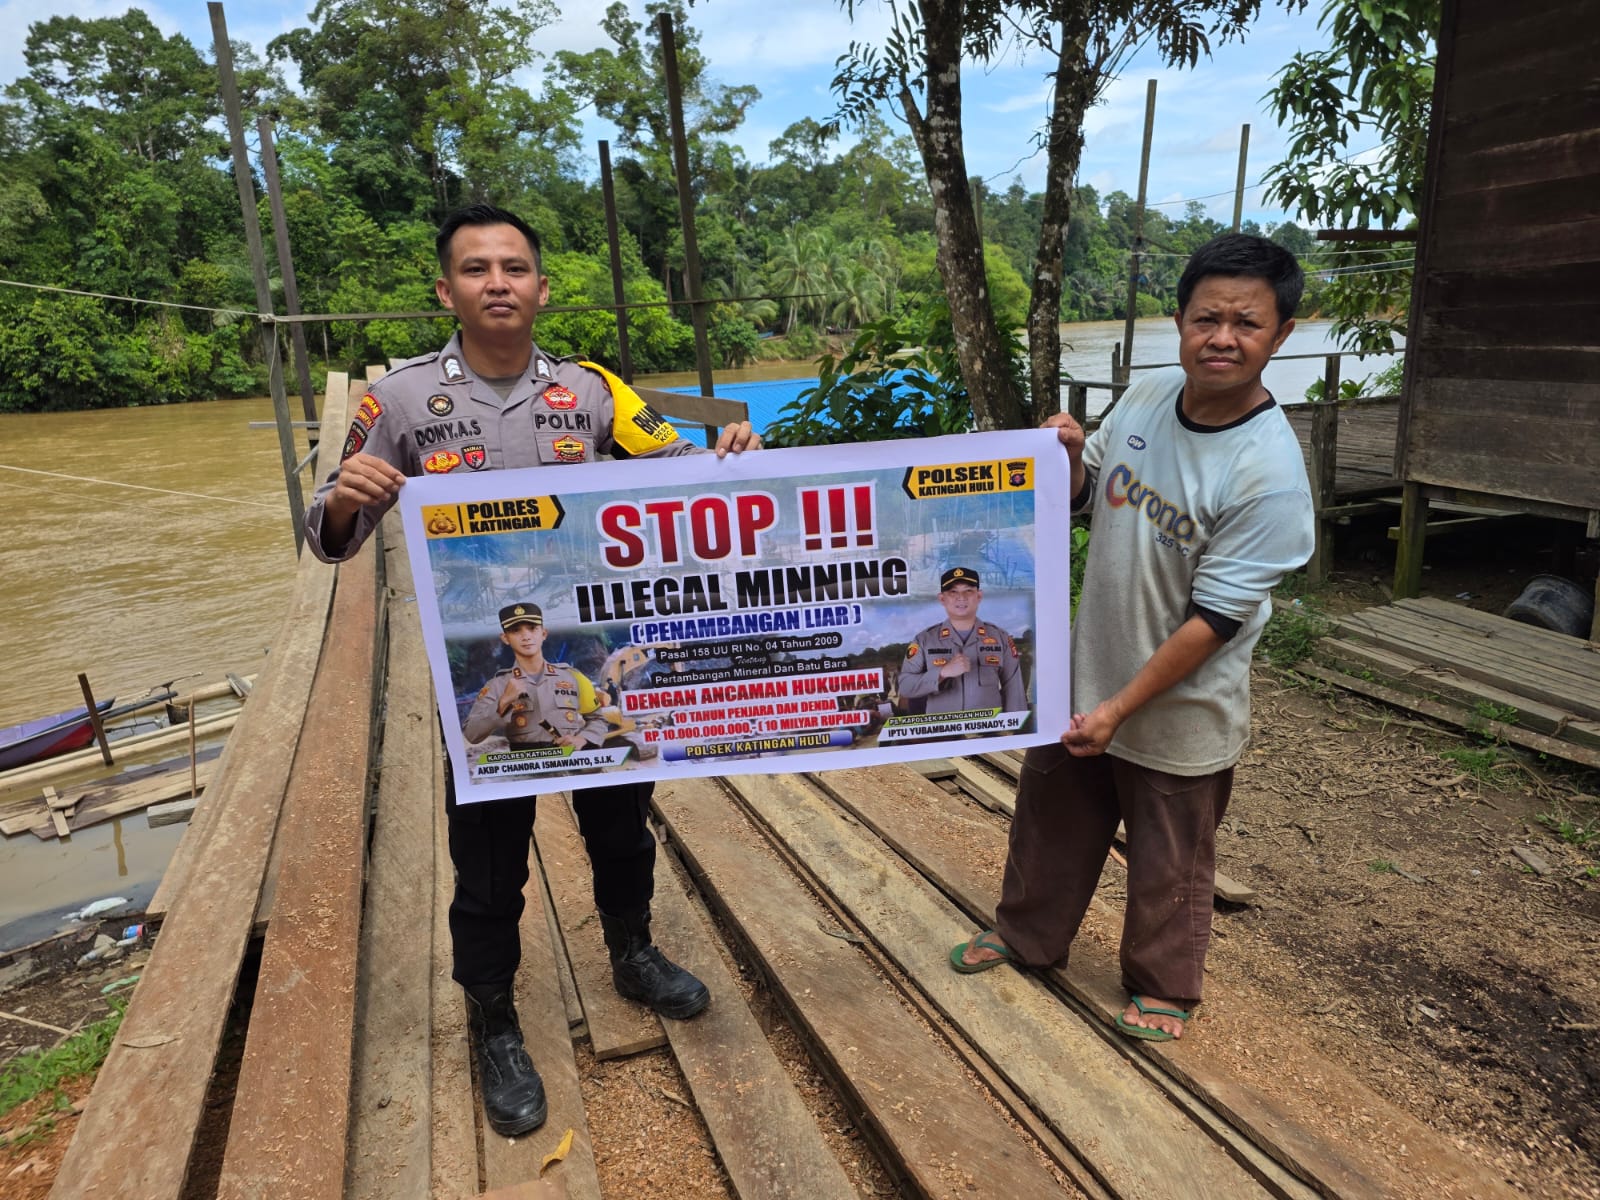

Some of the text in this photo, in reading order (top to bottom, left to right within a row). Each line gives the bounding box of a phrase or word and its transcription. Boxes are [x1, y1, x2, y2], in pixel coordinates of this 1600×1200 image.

[534, 413, 592, 430] POLRI
[918, 465, 993, 485] POLSEK
[919, 481, 994, 497] KATINGAN HULU
[467, 499, 540, 520] POLRES
[1105, 463, 1196, 543] Corona
[469, 515, 542, 534] KATINGAN
[601, 486, 874, 568] STOP !!!
[576, 558, 908, 623] ILLEGAL MINNING
[660, 635, 839, 660] Pasal 158 UU RI No. 04 Tahun 2009
[655, 659, 847, 684] Pertambangan Mineral Dan Batu Bara
[625, 672, 880, 711] DENGAN ANCAMAN HUKUMAN
[674, 699, 837, 724] 10 TAHUN PENJARA DAN DENDA
[901, 715, 938, 724] KAPOLSEK
[938, 713, 974, 721] KATINGAN
[974, 710, 993, 718] HULU
[780, 716, 818, 730] MILYAR
[888, 718, 1019, 738] IPTU YUBAMBANG KUSNADY, SH
[686, 733, 831, 757] POLSEK KATINGAN HULU
[478, 764, 500, 775] AKBP
[502, 761, 541, 773] CHANDRA
[542, 756, 593, 769] ISMAWANTO,
[487, 748, 563, 763] KAPOLRES KATINGAN
